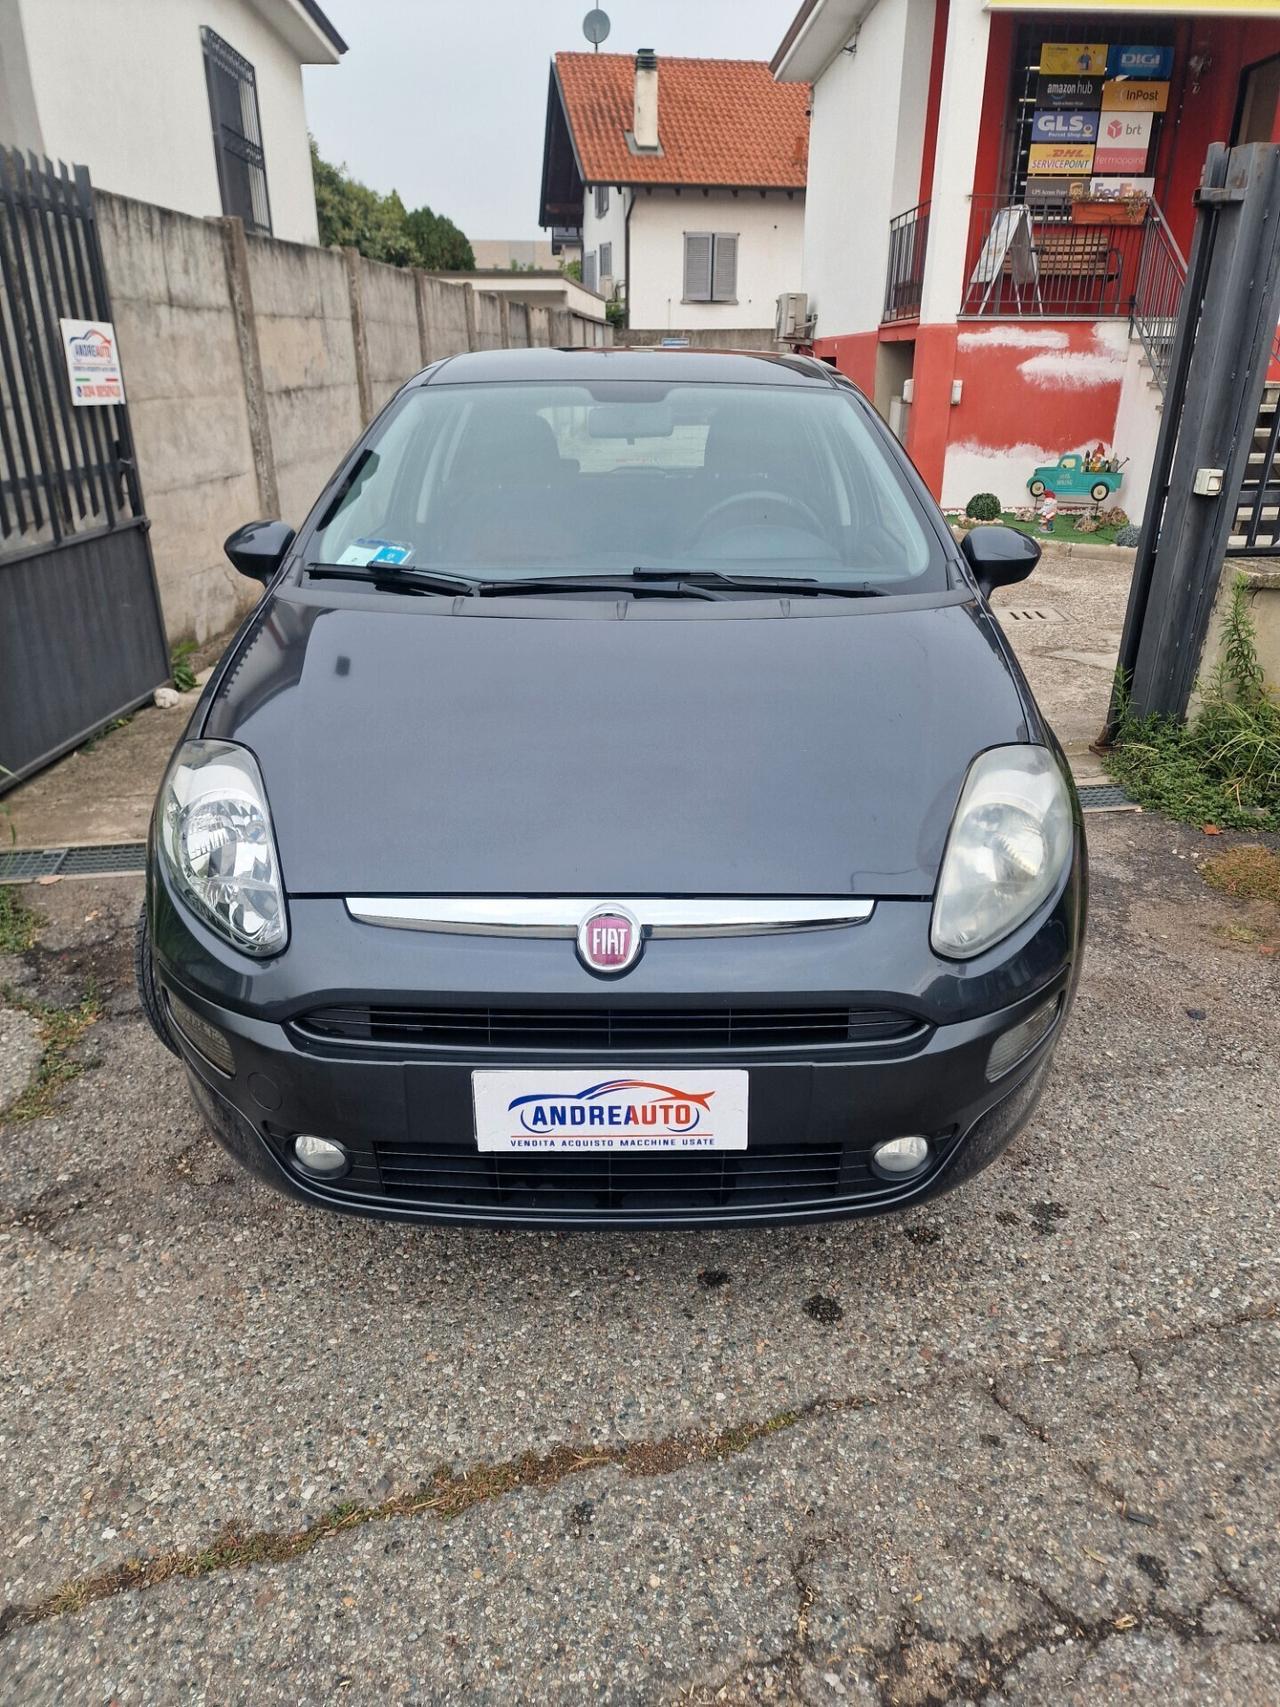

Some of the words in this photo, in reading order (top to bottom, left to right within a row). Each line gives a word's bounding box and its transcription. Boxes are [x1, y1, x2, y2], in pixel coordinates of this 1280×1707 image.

[1121, 54, 1161, 65] DIGI
[1047, 83, 1076, 94] amazon
[1077, 80, 1093, 94] hub
[1126, 89, 1159, 101] InPost
[1037, 114, 1084, 132] GLS
[1125, 124, 1143, 135] brt
[1051, 149, 1085, 158] DHL
[1032, 159, 1090, 169] SERVICEPOINT
[1094, 182, 1148, 198] FedE
[592, 927, 629, 955] FIAT
[531, 1105, 692, 1126] ANDREAUTO
[510, 1139, 556, 1147] VENDITA
[561, 1139, 613, 1147] ACQUISTO
[620, 1138, 676, 1146] MACCHINE
[682, 1137, 715, 1146] USATE
